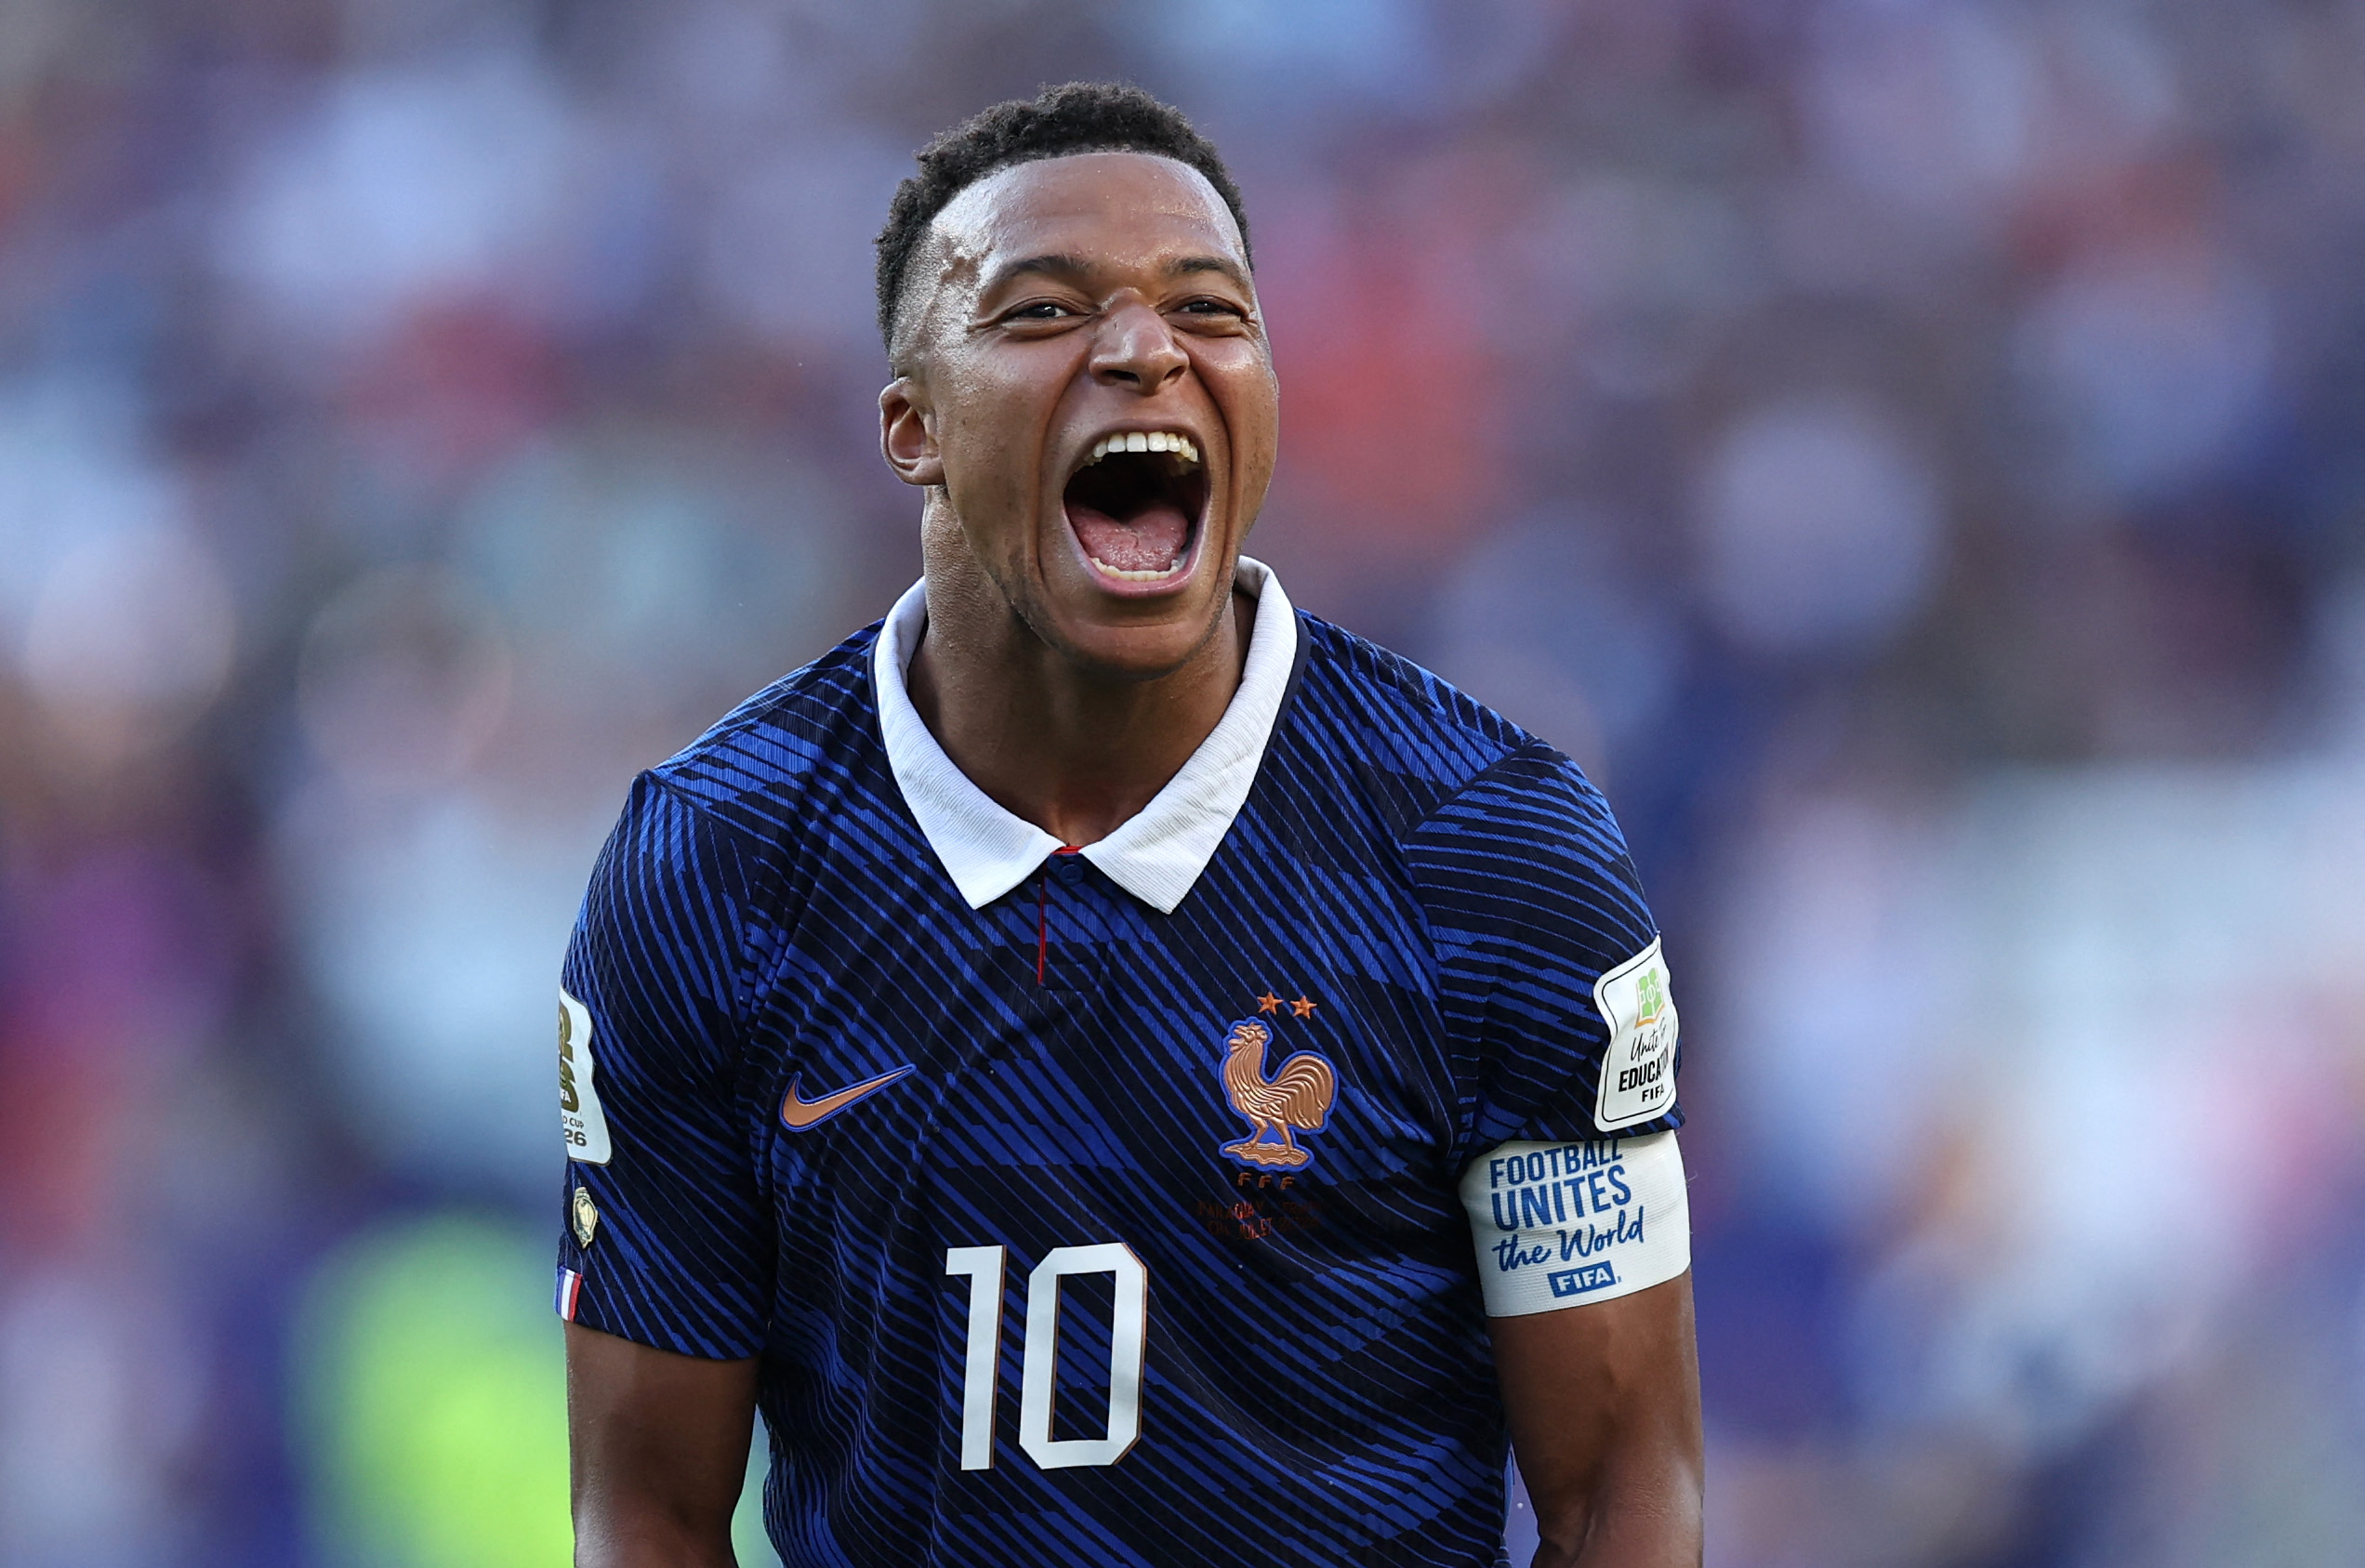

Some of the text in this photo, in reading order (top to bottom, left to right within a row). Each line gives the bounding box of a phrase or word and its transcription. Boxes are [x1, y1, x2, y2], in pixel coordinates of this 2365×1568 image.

[1631, 1028, 1659, 1062] Unite
[1642, 1083, 1665, 1102] FIFA
[564, 1128, 587, 1147] 26
[569, 1117, 585, 1128] CUP
[1490, 1140, 1623, 1189] FOOTBALL
[1491, 1165, 1632, 1232] UNITES
[1492, 1206, 1645, 1272] the World
[1556, 1268, 1612, 1293] FIFA
[945, 1242, 1148, 1470] 10
